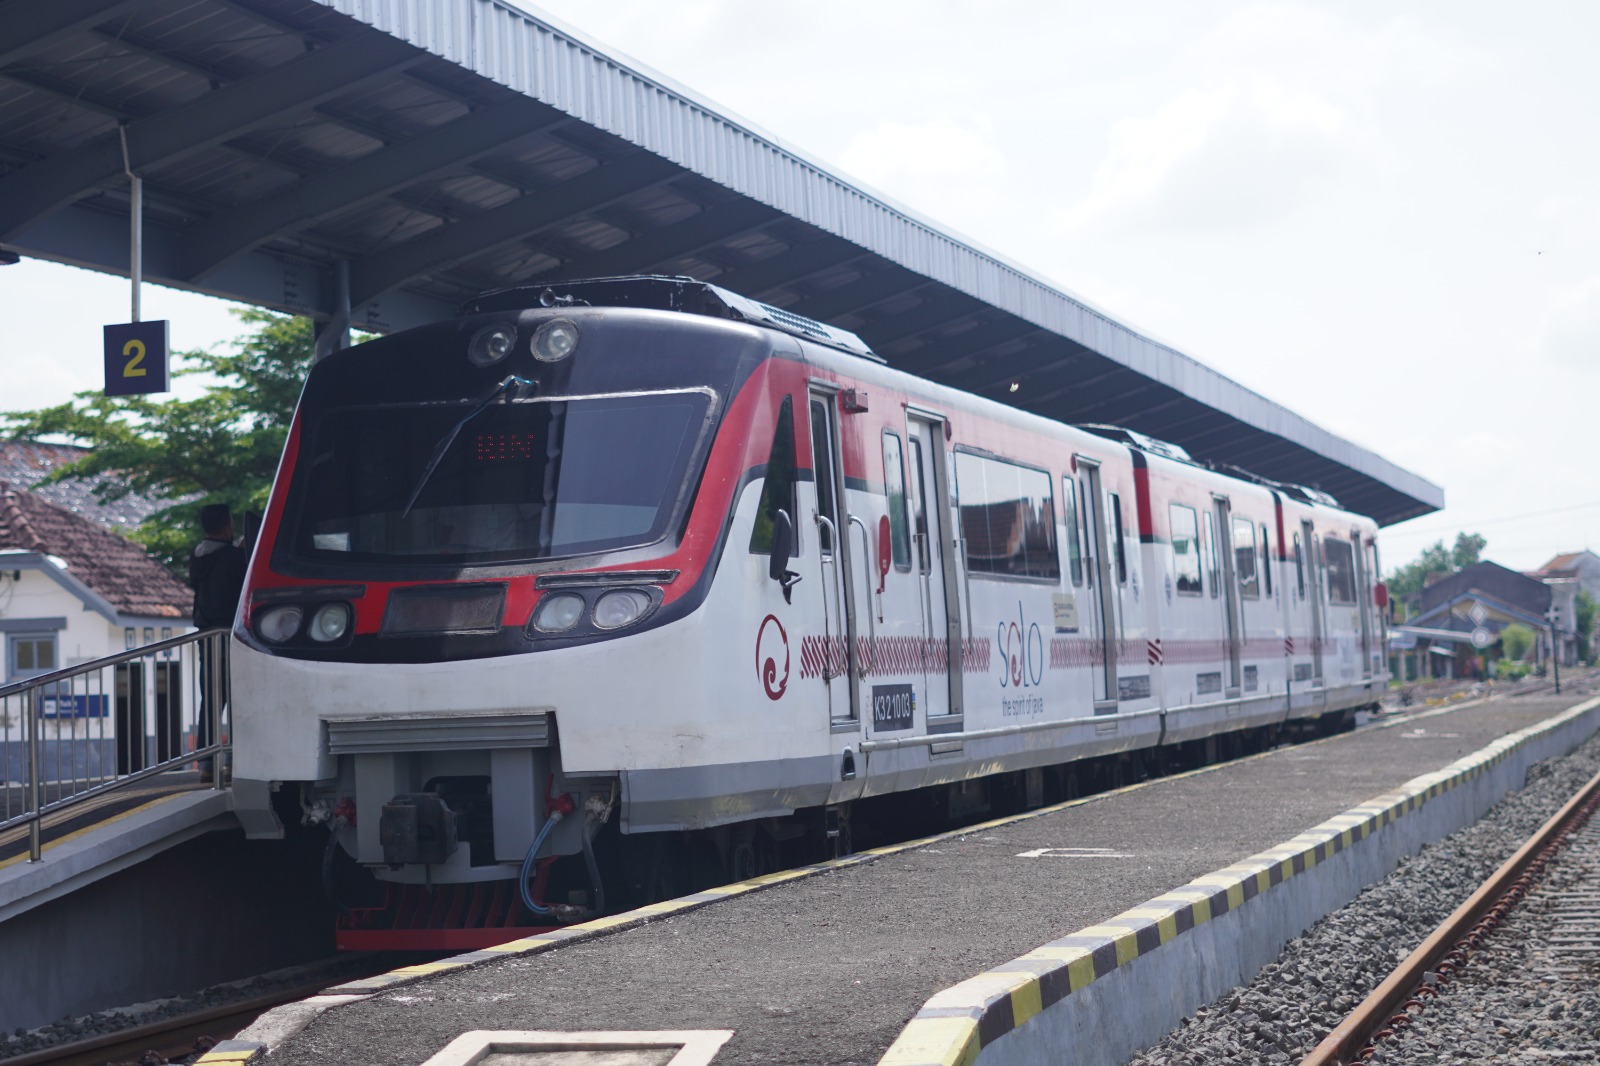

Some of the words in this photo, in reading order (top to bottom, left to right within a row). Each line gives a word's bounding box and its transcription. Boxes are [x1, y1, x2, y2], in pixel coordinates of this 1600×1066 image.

[122, 339, 147, 378] 2
[1002, 696, 1012, 717] the
[1012, 694, 1026, 720] spirit
[1026, 693, 1032, 716] of
